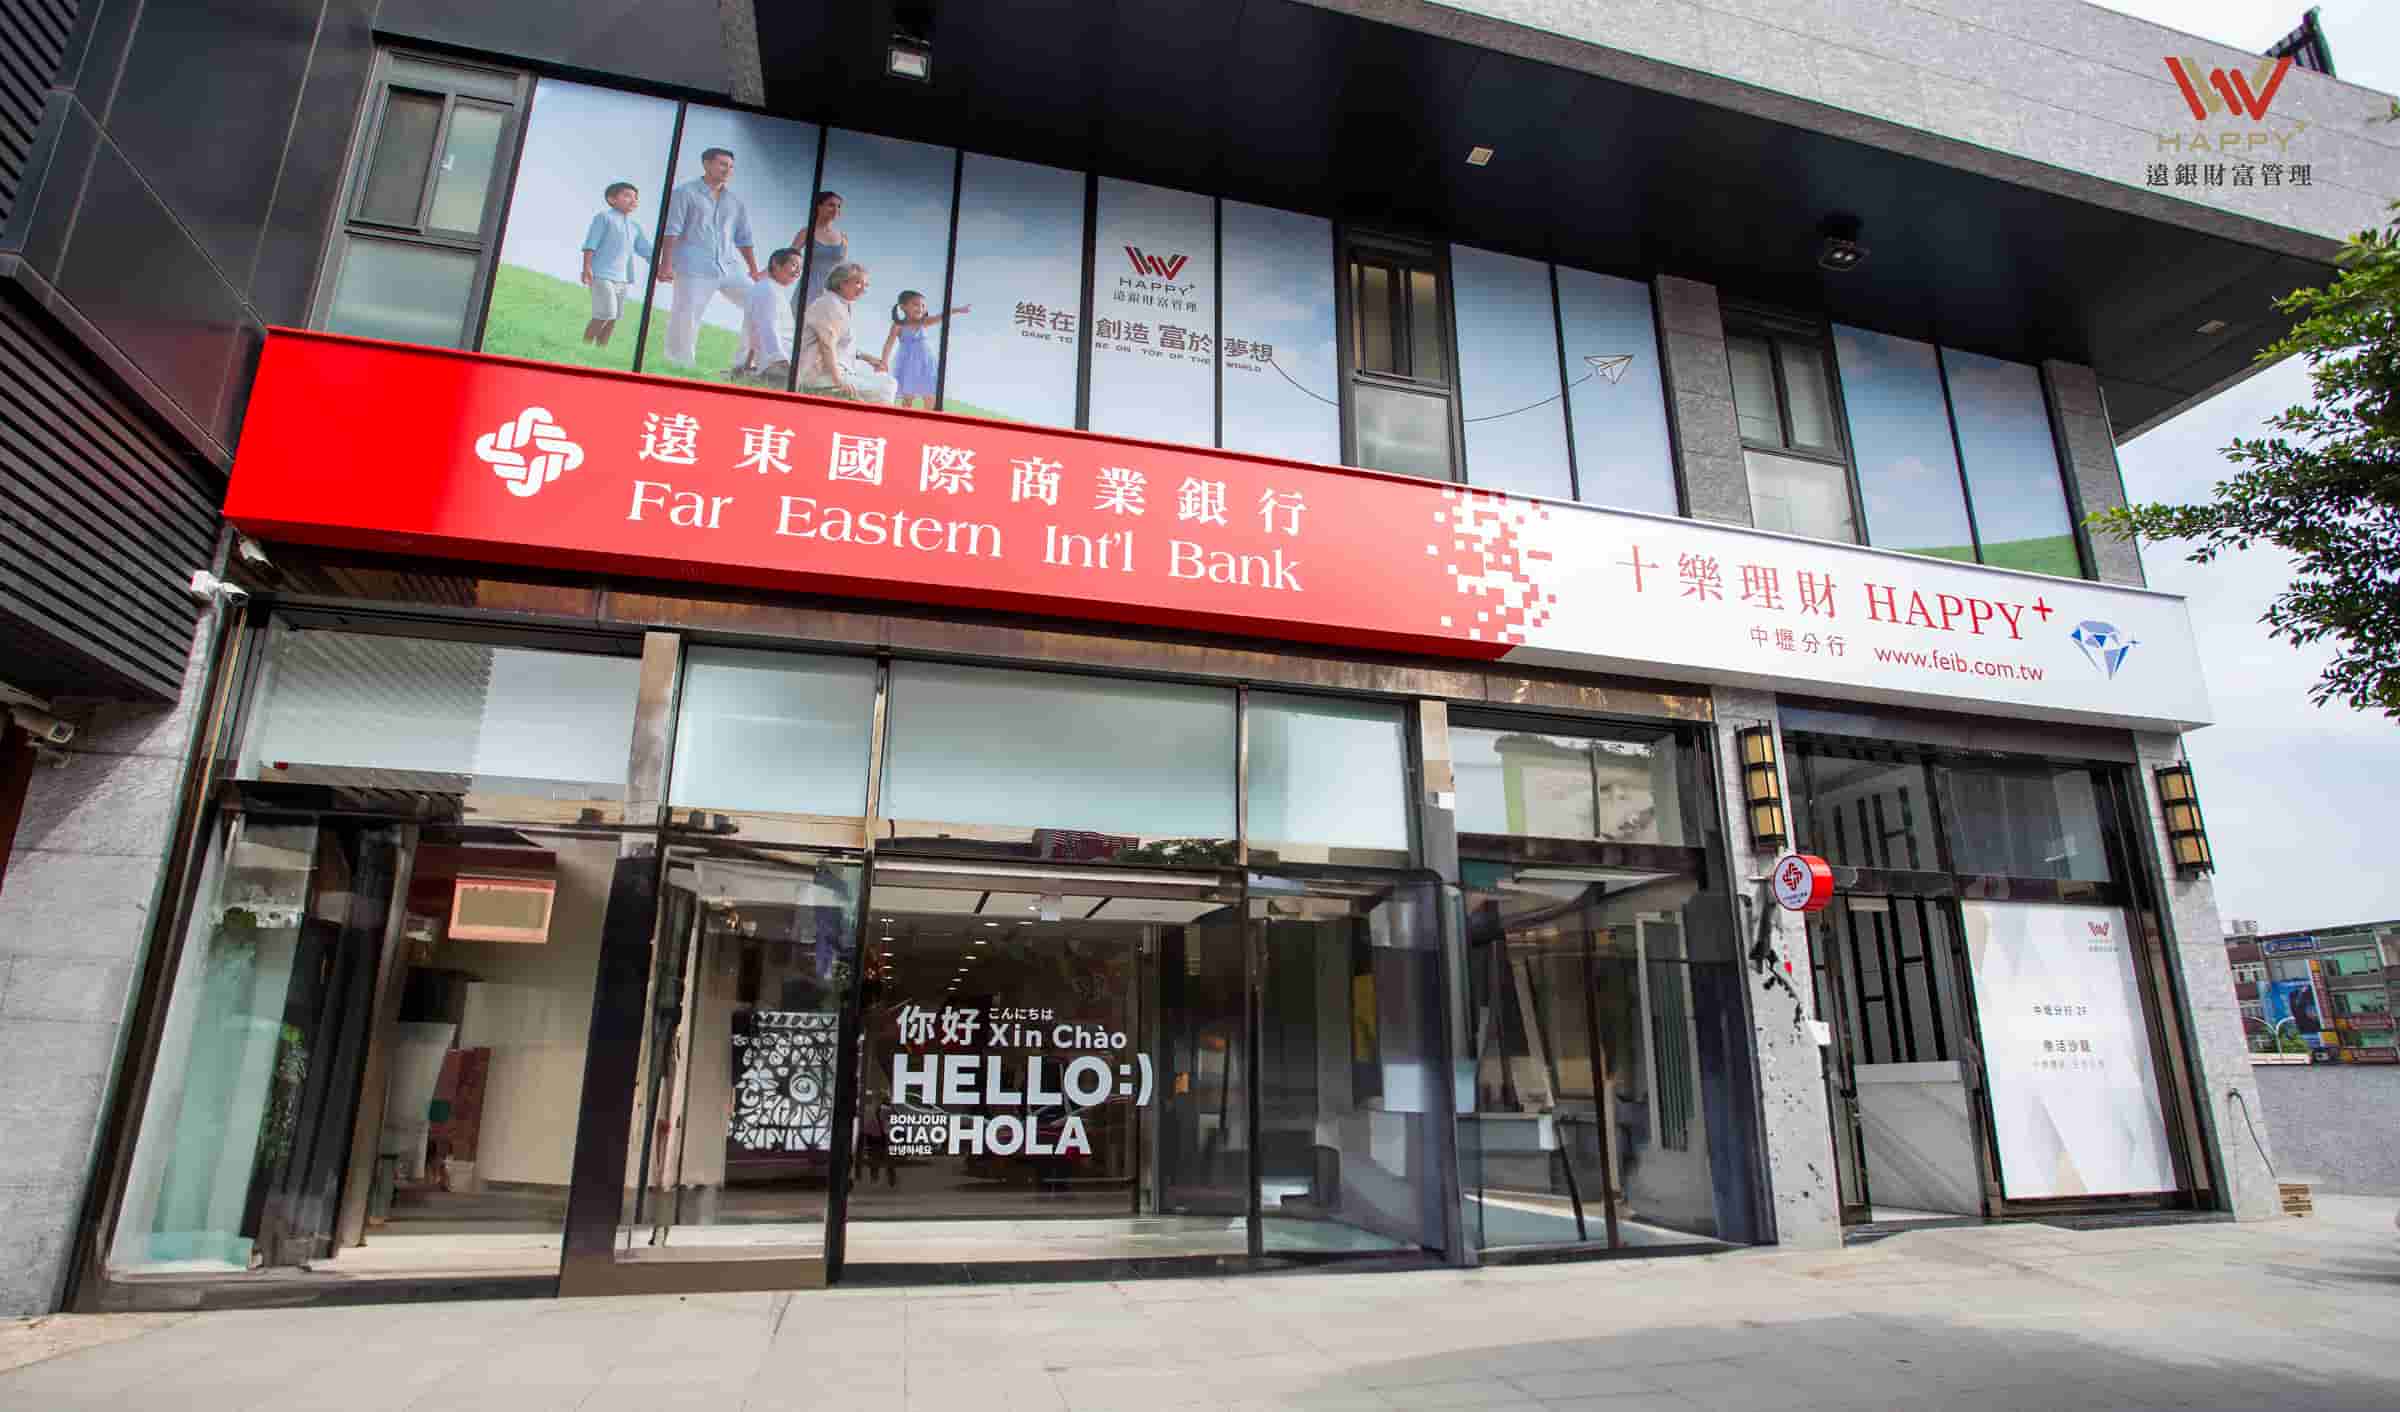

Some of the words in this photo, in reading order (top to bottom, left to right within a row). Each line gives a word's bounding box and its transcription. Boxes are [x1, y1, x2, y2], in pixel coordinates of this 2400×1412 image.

[1096, 317, 1151, 346] 創造
[637, 411, 1309, 537] 遠東國際商業銀行
[626, 479, 734, 530] Far
[774, 495, 1004, 559] Eastern
[1040, 523, 1134, 573] Int'l
[1167, 539, 1305, 592] Bank
[1615, 543, 1838, 620] 十樂理財
[1748, 625, 1847, 658] 中壢分行
[1873, 644, 2045, 683] www.feib.com.tw
[896, 1004, 981, 1047] 你好
[987, 1006, 1055, 1022] こんにちは
[987, 1022, 1043, 1049] Xin
[1052, 1022, 1129, 1050] Chào
[888, 1113, 948, 1127] BONJOUR
[888, 1126, 948, 1145] CIAO
[947, 1114, 1093, 1156] HOLA
